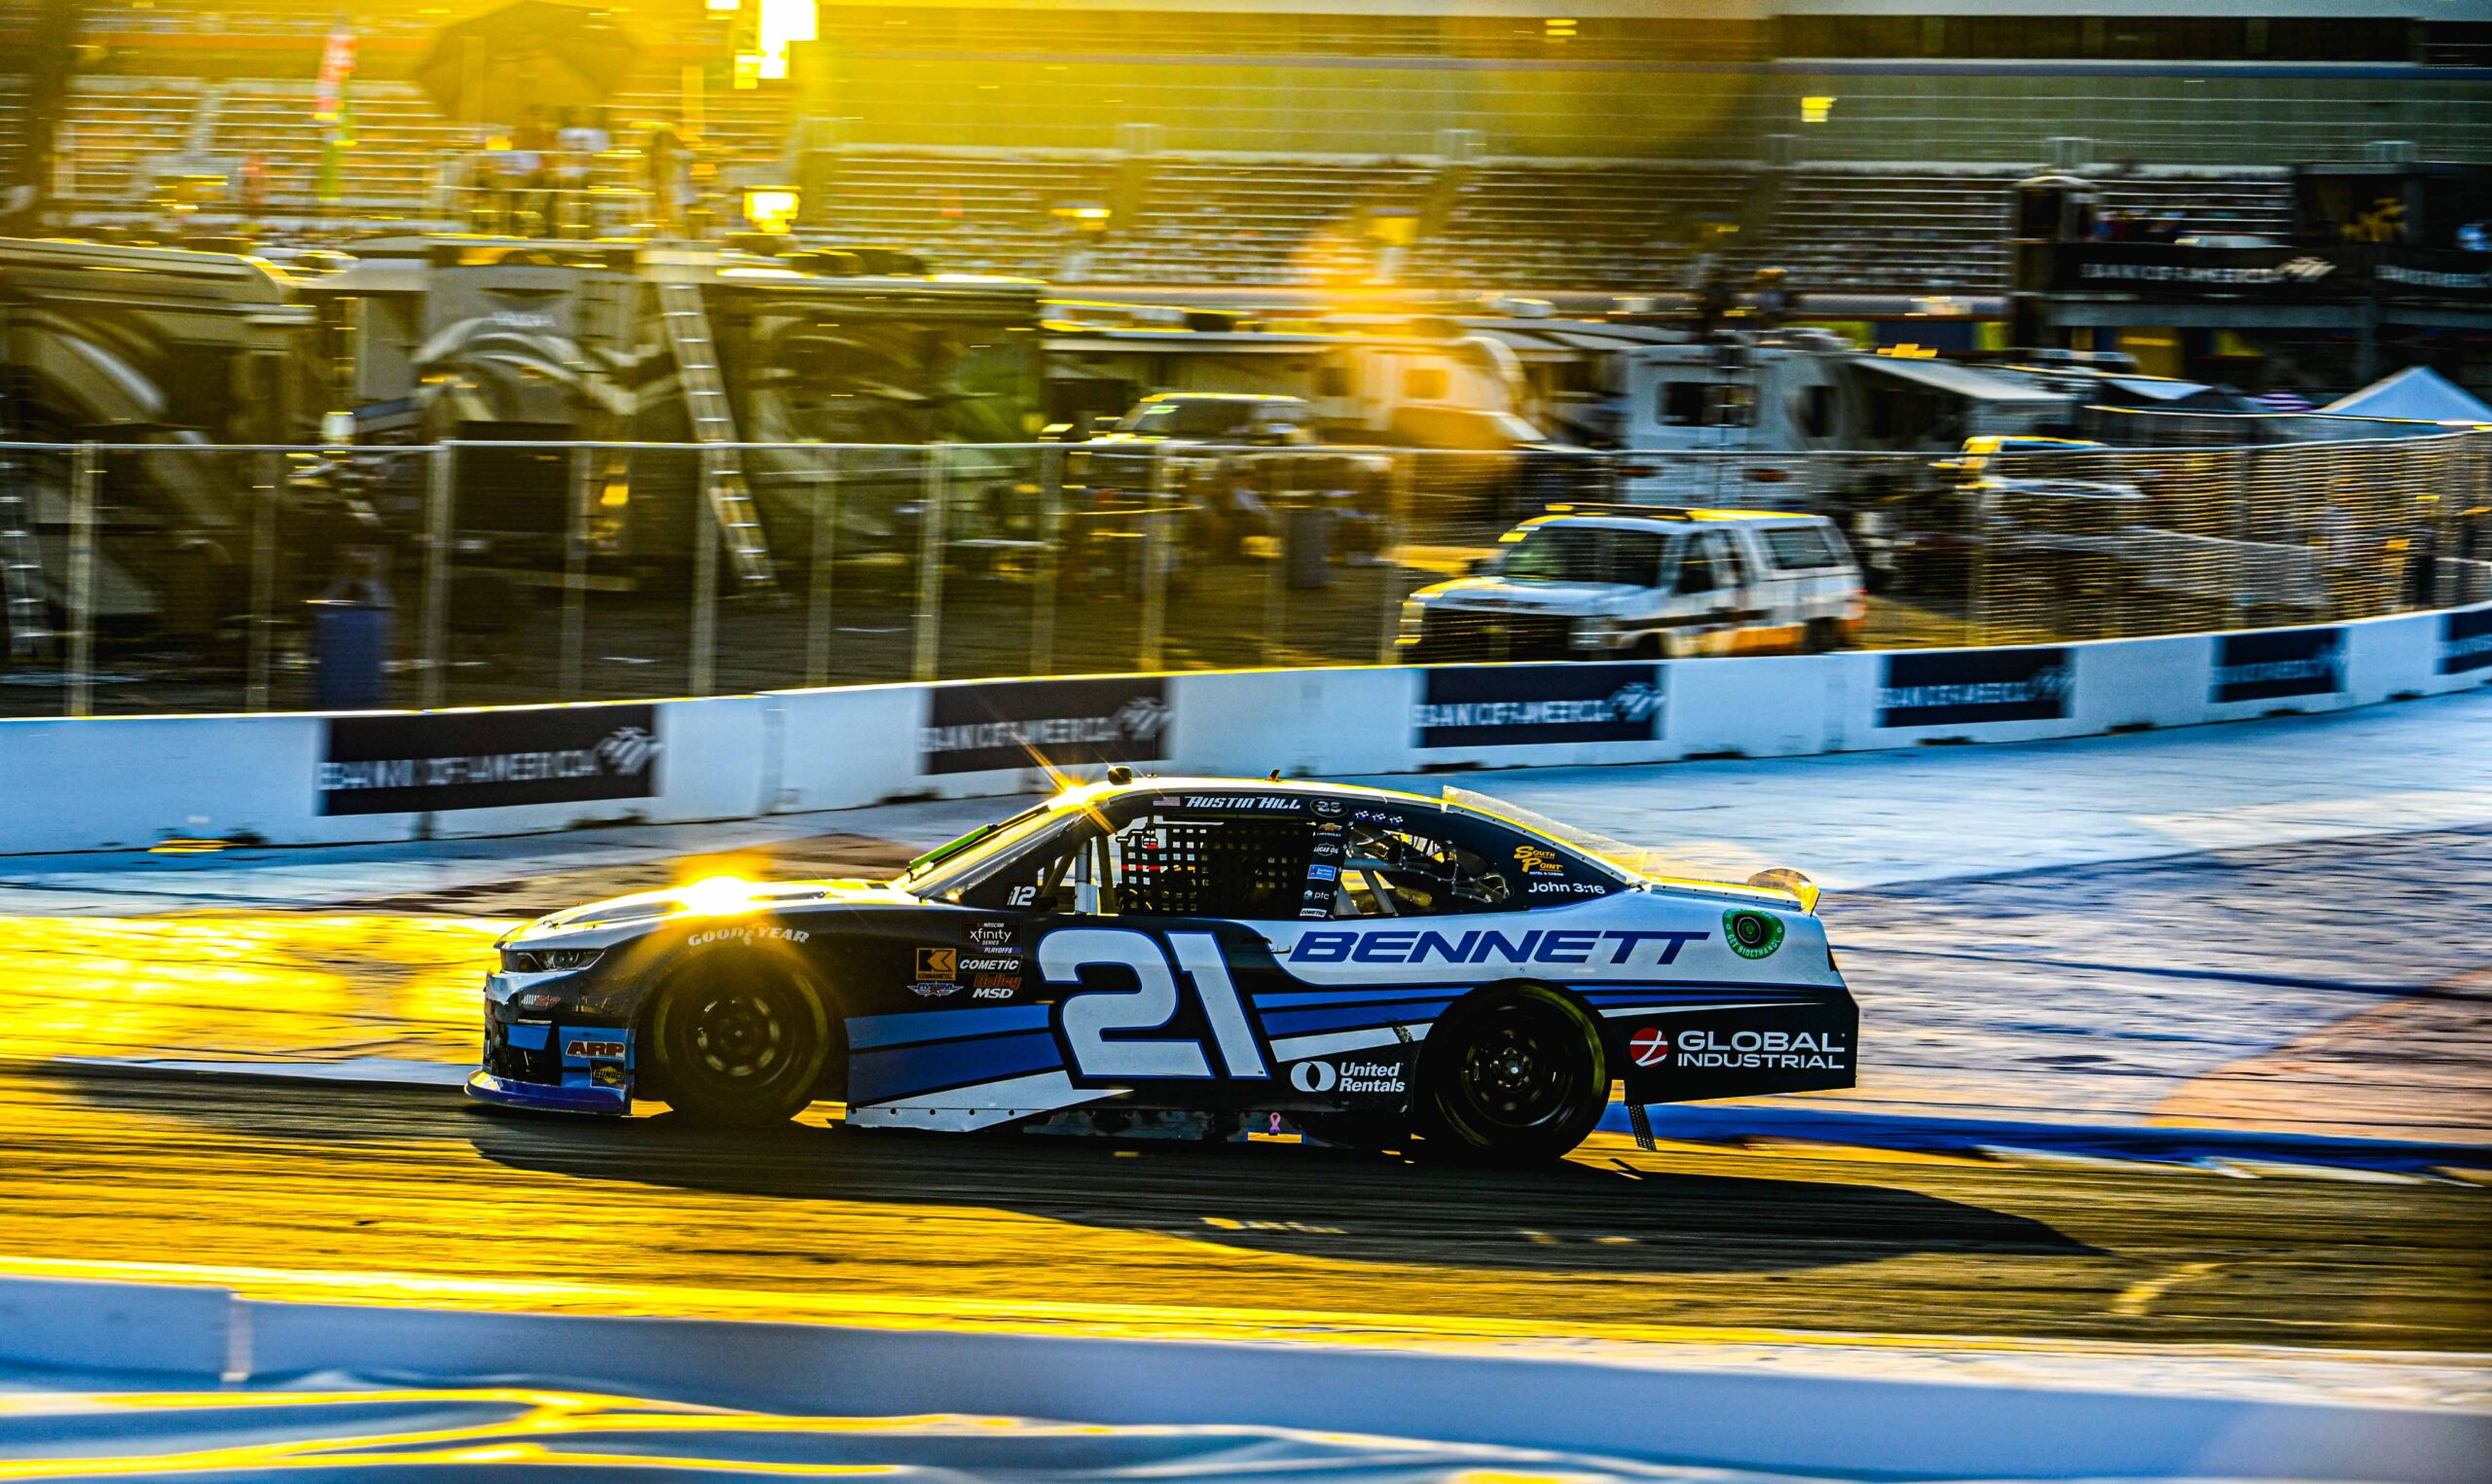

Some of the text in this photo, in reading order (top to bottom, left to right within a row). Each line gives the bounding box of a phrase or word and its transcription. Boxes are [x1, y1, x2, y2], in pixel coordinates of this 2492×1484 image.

[1185, 796, 1301, 810] AUSTIN HILL
[1514, 846, 1556, 860] SOUTH
[1521, 857, 1564, 873] POINT
[1008, 886, 1037, 906] 12
[1314, 891, 1330, 900] ptc
[1527, 882, 1606, 894] John 3:16
[970, 927, 1012, 943] xfinity
[1287, 929, 1711, 965] BENNETT
[959, 959, 1019, 970] COMETIC
[971, 988, 1014, 998] MSD
[1036, 926, 1271, 1080] 21
[1677, 1030, 1846, 1053] GLOBAL
[566, 1040, 625, 1060] ARP
[1677, 1053, 1846, 1069] INDUSTRIAL
[1339, 1062, 1401, 1077] United
[1338, 1077, 1406, 1093] Rentals
